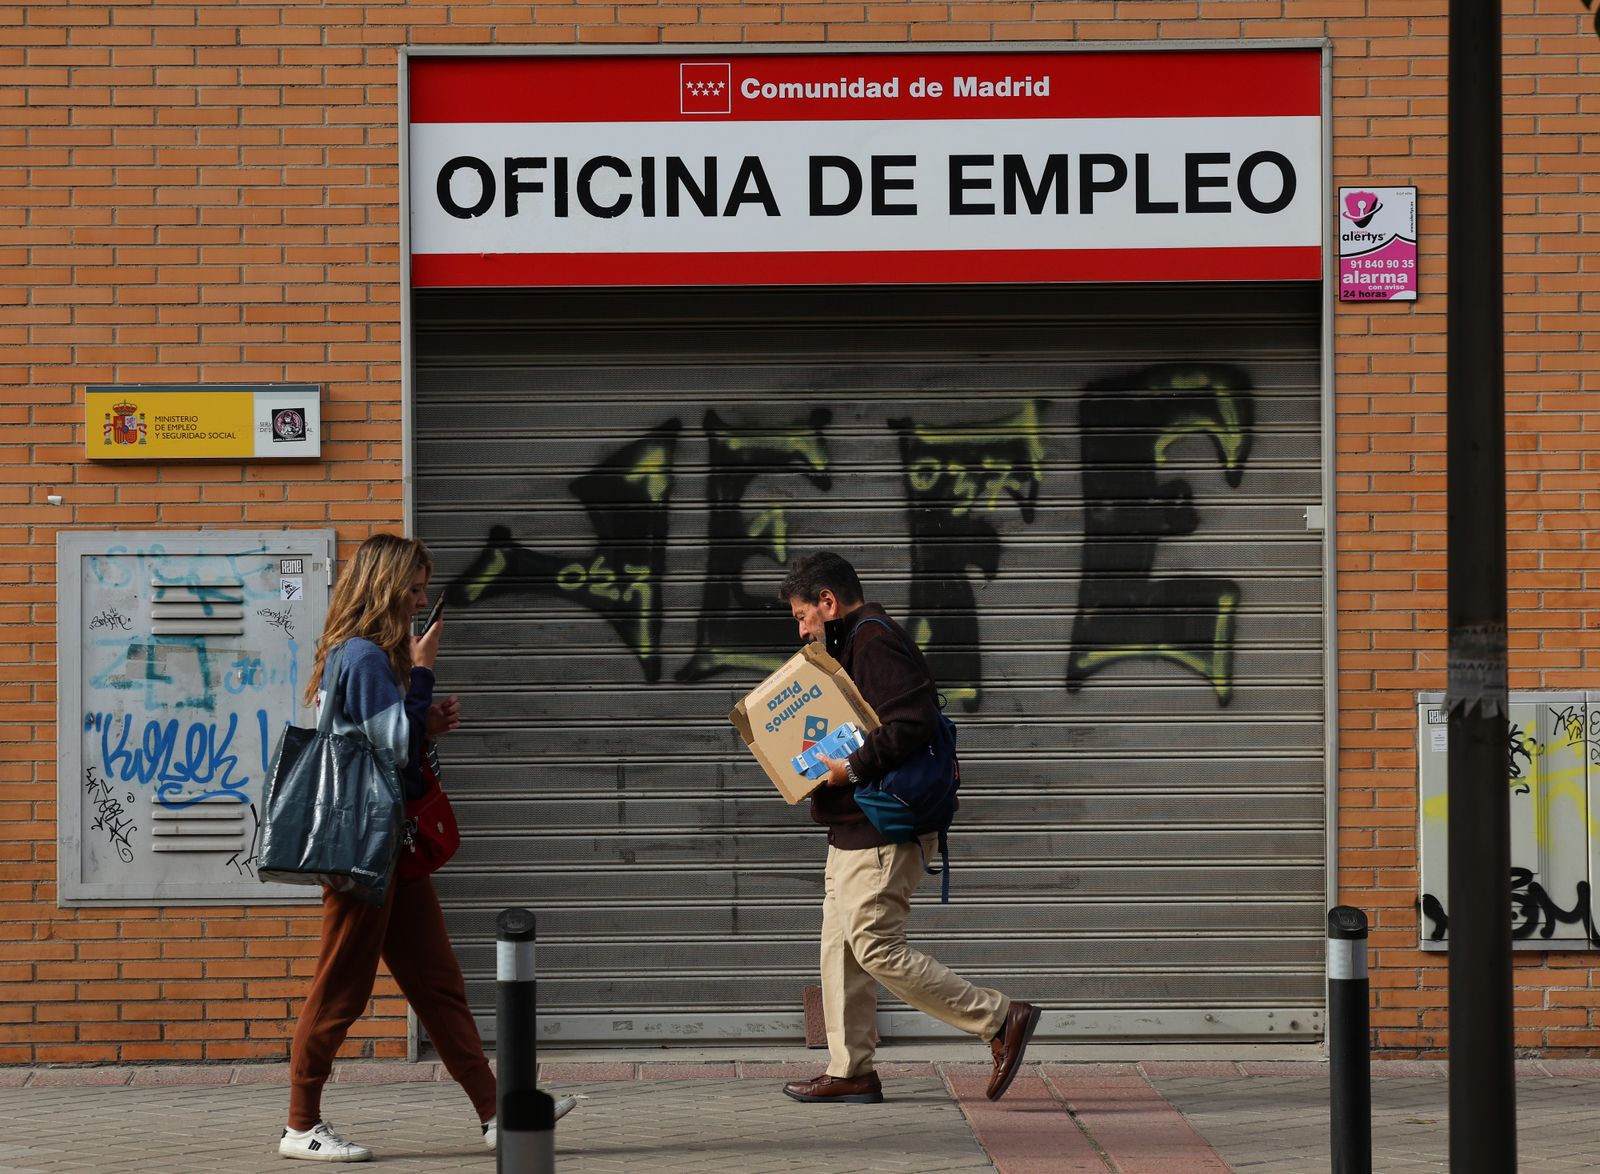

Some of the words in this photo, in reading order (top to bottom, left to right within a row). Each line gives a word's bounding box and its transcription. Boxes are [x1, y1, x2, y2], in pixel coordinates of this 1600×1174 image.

[740, 77, 899, 99] Comunidad
[909, 76, 944, 98] de
[953, 75, 1051, 98] Madrid
[436, 154, 781, 220] OFICINA
[808, 154, 918, 217] DE
[948, 150, 1298, 216] EMPLEO
[1342, 230, 1384, 244] alertys
[1350, 259, 1362, 269] 91
[1364, 259, 1384, 269] 840
[1386, 259, 1399, 269] 90
[1401, 259, 1415, 269] 35
[1342, 270, 1409, 284] alarma
[1384, 283, 1406, 291] aviso
[1343, 289, 1356, 298] 24
[1358, 289, 1388, 298] horas
[154, 415, 199, 423] MINISTERIO
[154, 424, 166, 432] DE
[167, 423, 198, 432] EMPLEO
[154, 432, 160, 440] Y
[161, 432, 207, 440] SEGURIDAD
[207, 431, 237, 440] SOCIAL
[766, 680, 803, 712] Pizza
[765, 684, 823, 733] Domino's
